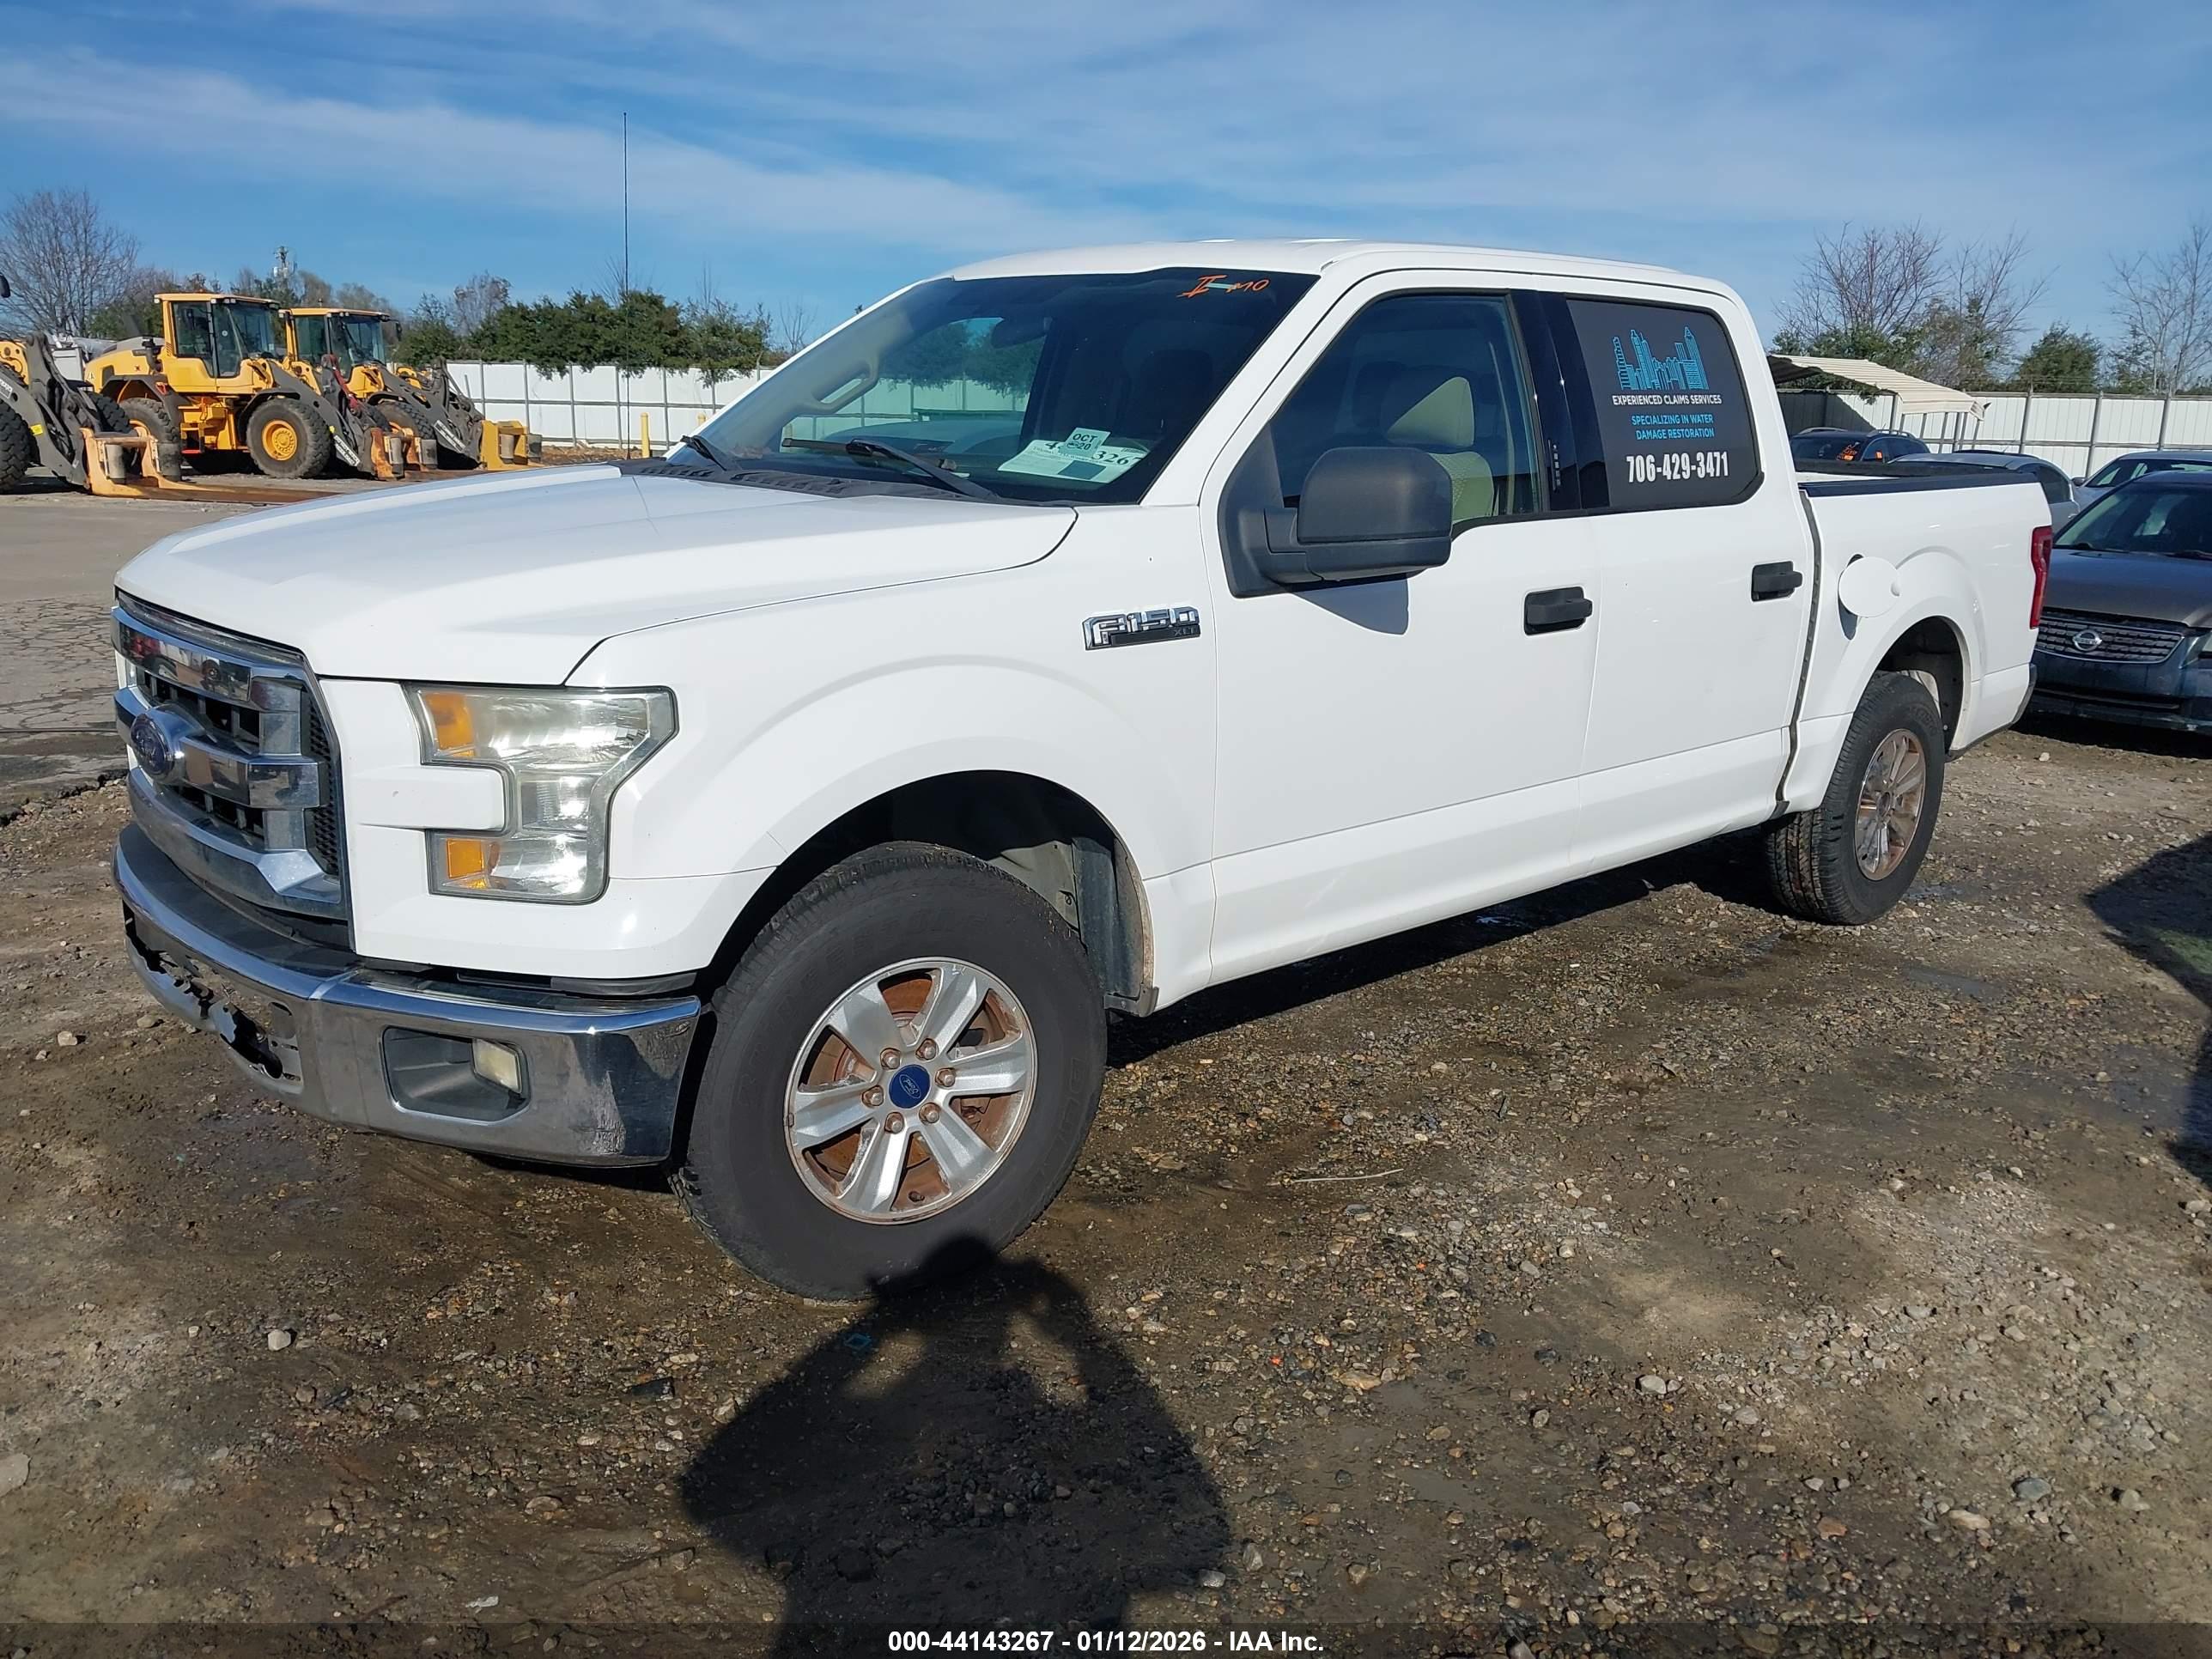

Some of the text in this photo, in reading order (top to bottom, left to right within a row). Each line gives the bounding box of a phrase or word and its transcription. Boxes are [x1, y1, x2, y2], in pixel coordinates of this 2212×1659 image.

[1612, 394, 1722, 406] EXPERIENCED CLAIMS SERVICES
[1632, 414, 1713, 425] SPECIALIZING IN WATER
[1073, 433, 1098, 443] OCT
[1636, 428, 1714, 441] DAMAGE RESTORATION
[1626, 451, 1729, 483] 706-429-3471
